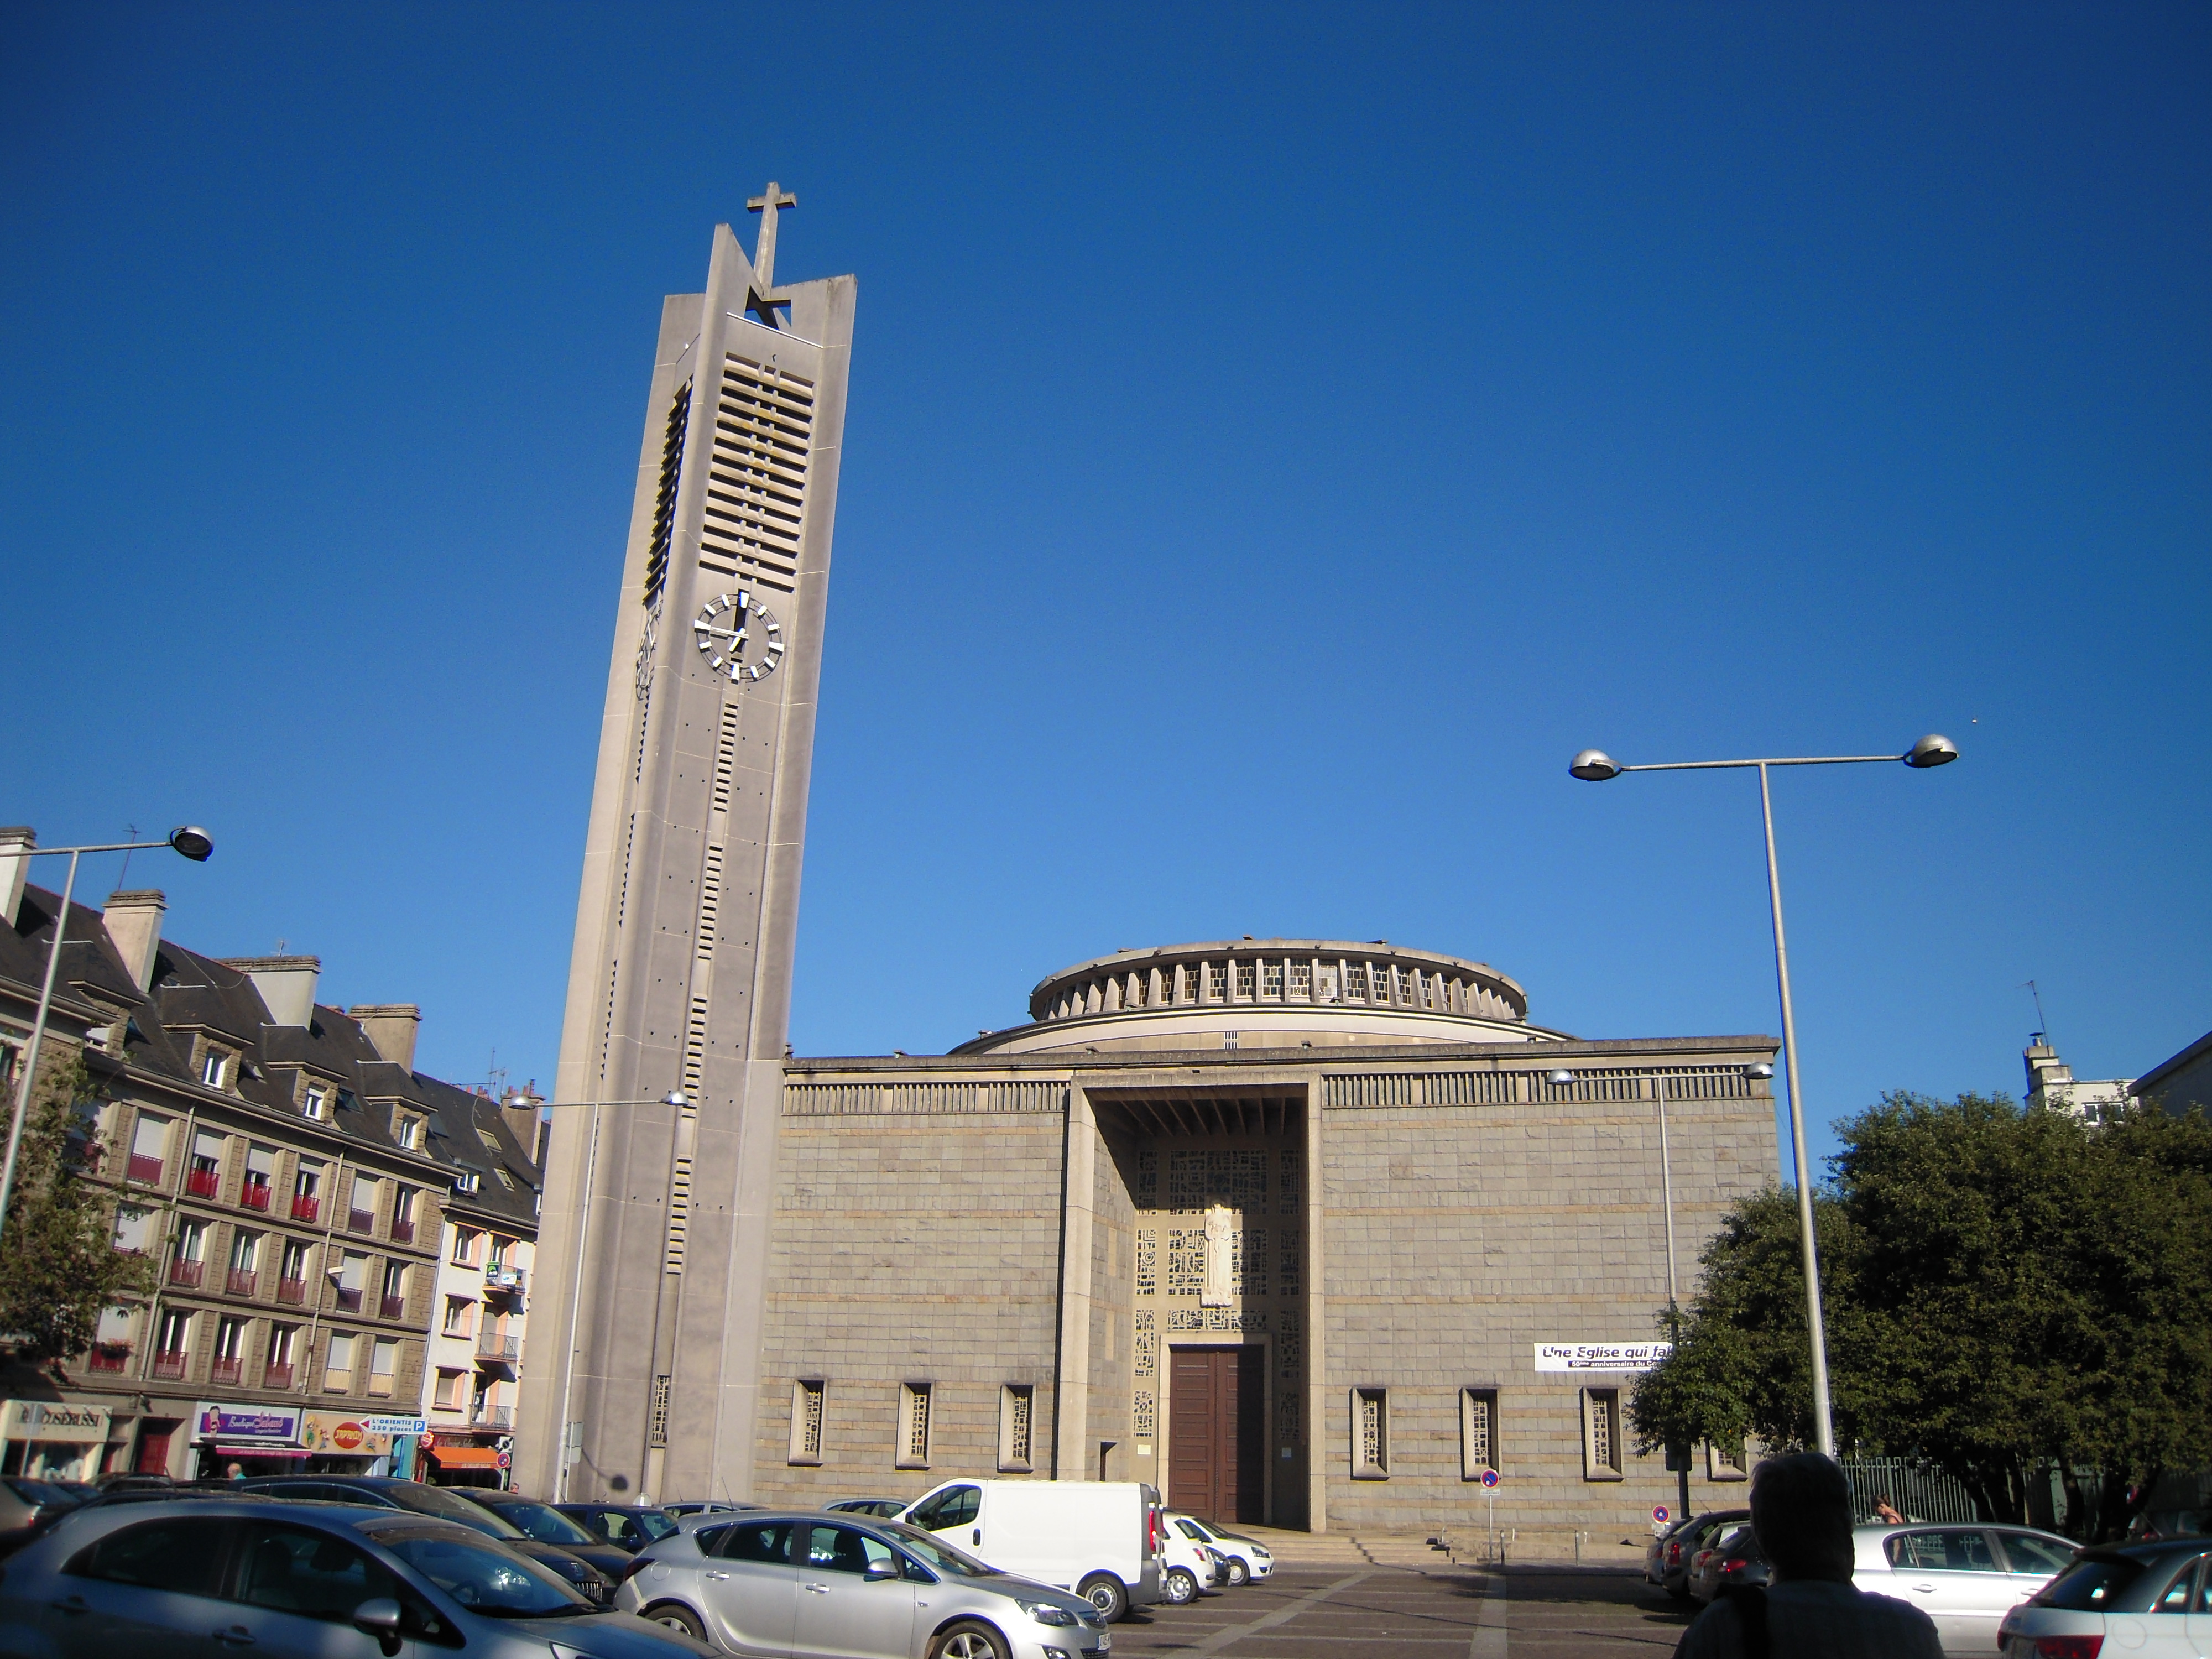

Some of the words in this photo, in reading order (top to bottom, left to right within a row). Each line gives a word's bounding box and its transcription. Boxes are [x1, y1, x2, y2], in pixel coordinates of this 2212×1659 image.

[1543, 1347, 1572, 1358] Une
[1577, 1347, 1620, 1359] Eglise
[1625, 1345, 1648, 1359] qui
[415, 1421, 422, 1431] P
